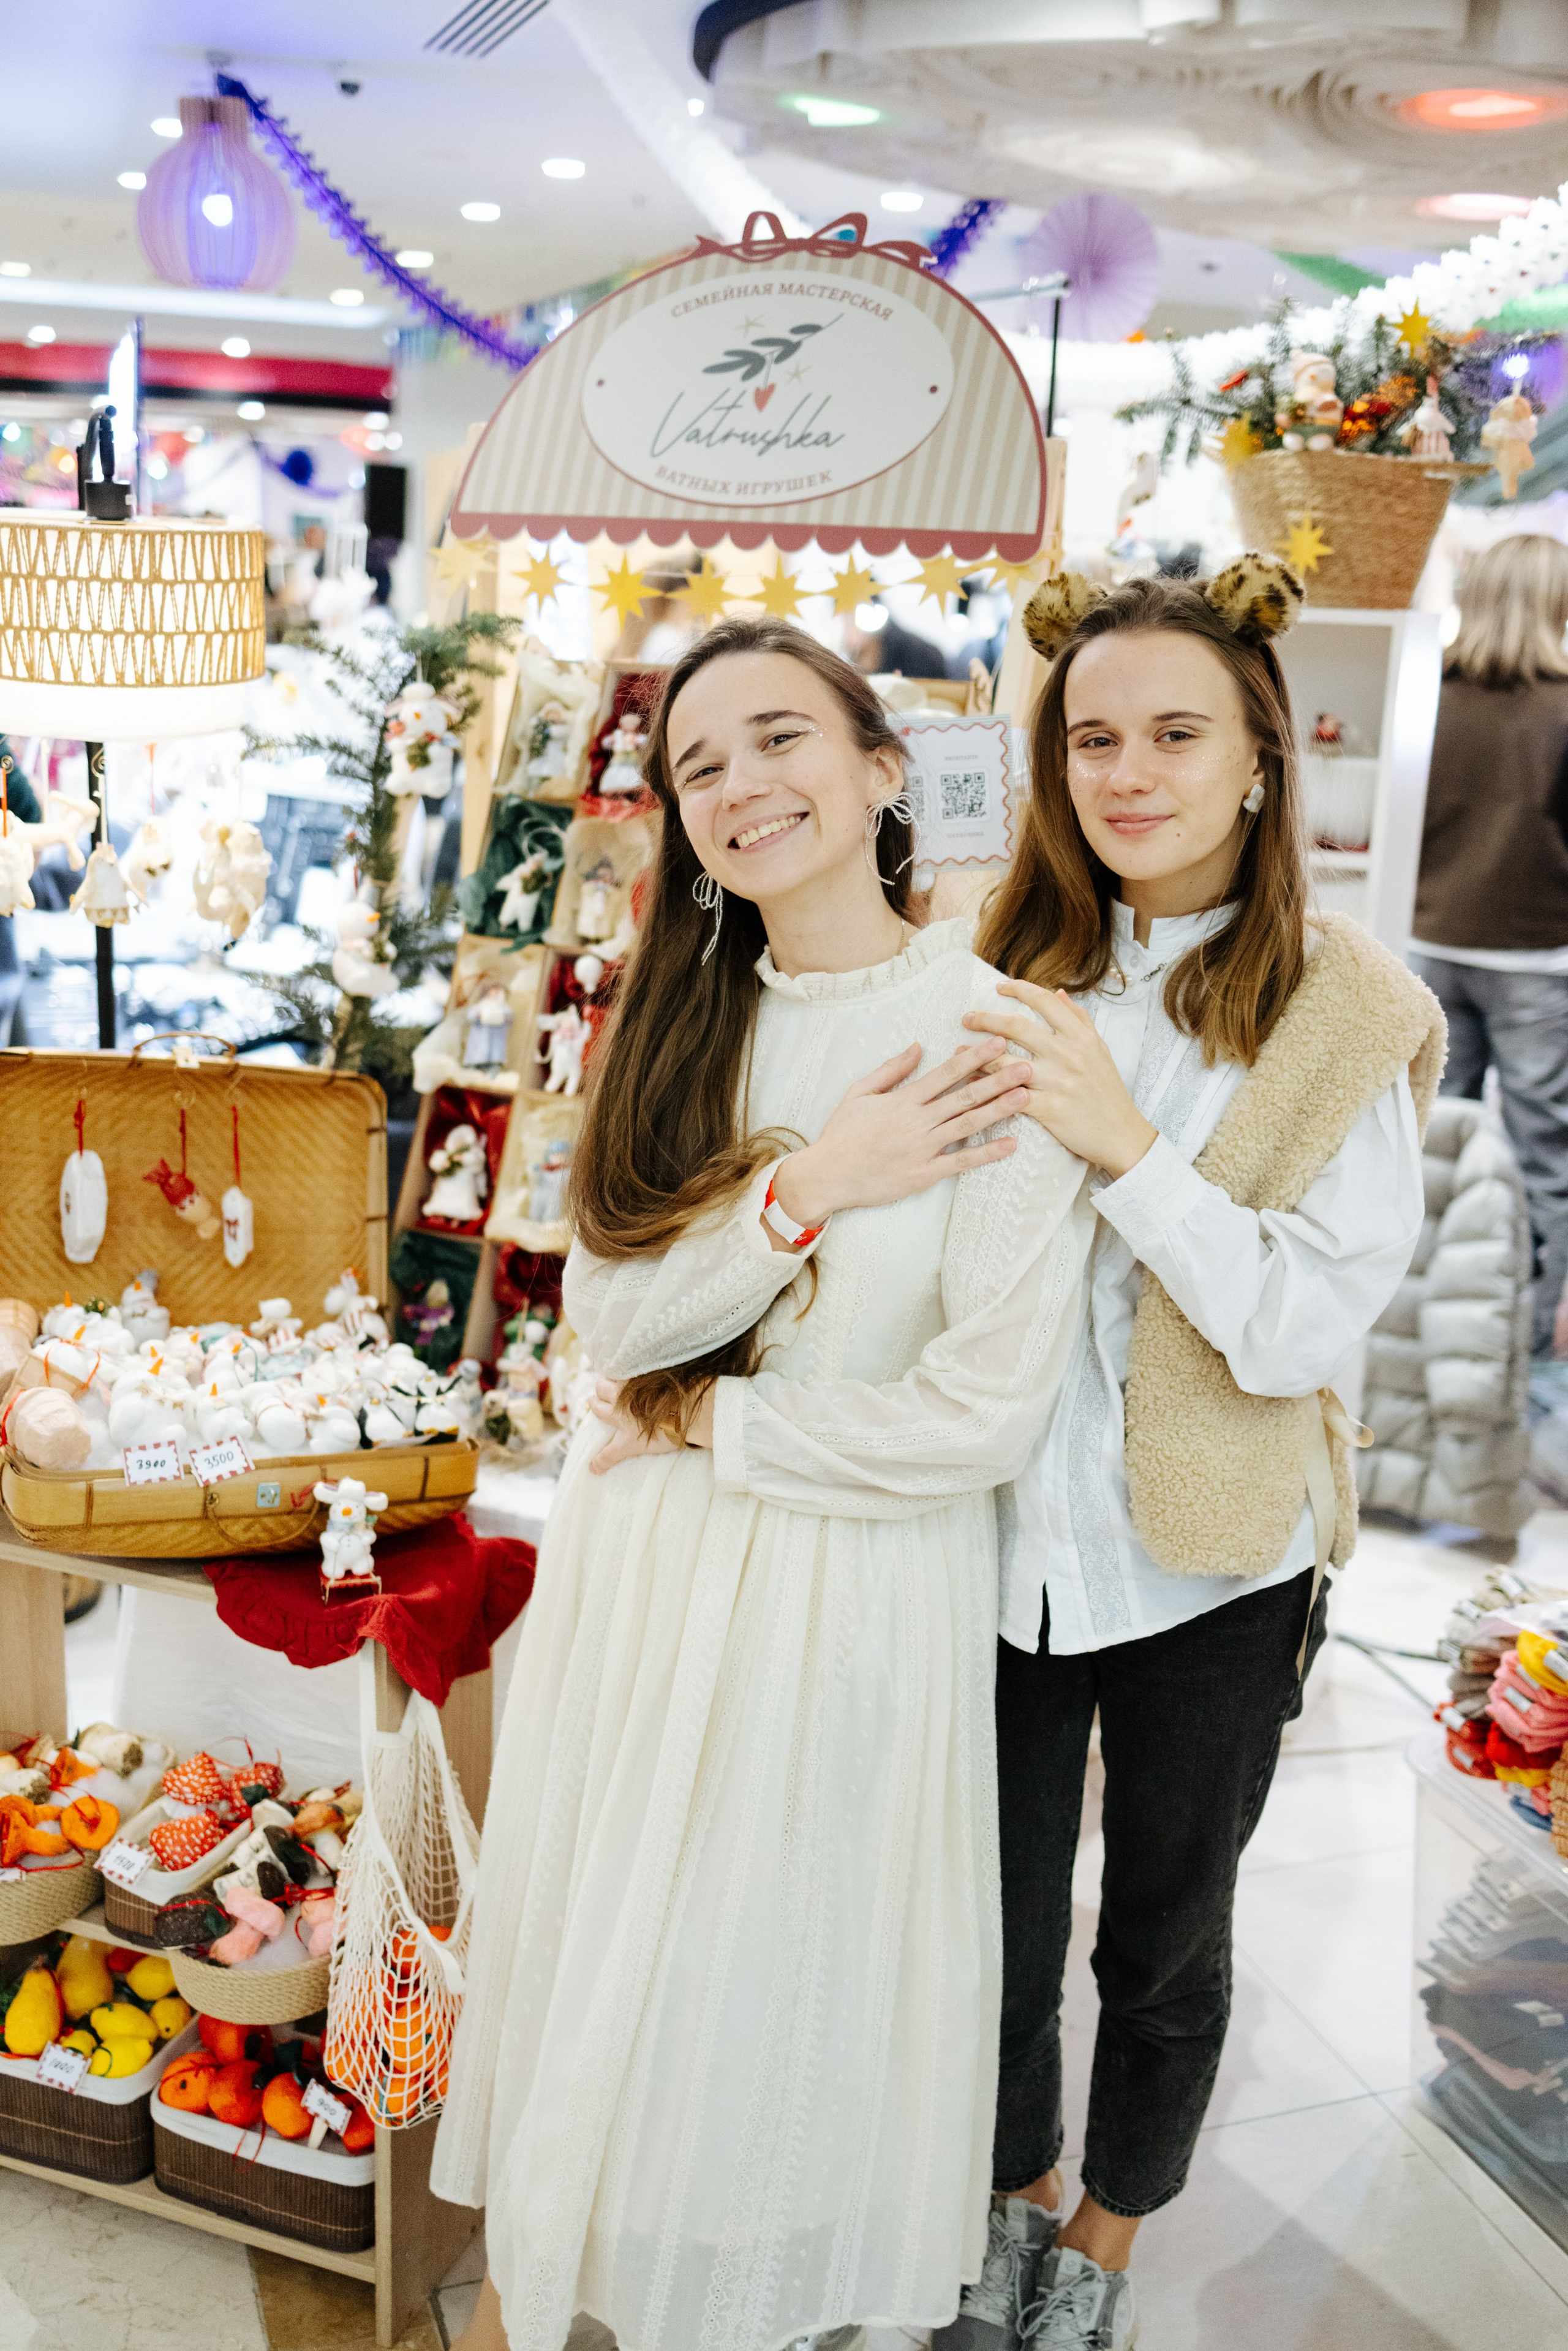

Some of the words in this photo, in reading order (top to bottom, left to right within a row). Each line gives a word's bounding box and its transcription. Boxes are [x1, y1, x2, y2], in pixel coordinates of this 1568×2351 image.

[671, 282, 774, 318] СЕМЕЙНАЯ
[777, 282, 894, 322] МАСТЕРСКАЯ
[650, 387, 845, 458] Vatrushka
[655, 464, 732, 495] ВАТНЫХ
[736, 469, 834, 496] ИГРУШЕК
[137, 1459, 166, 1470] 3900
[205, 1451, 234, 1470] 3500
